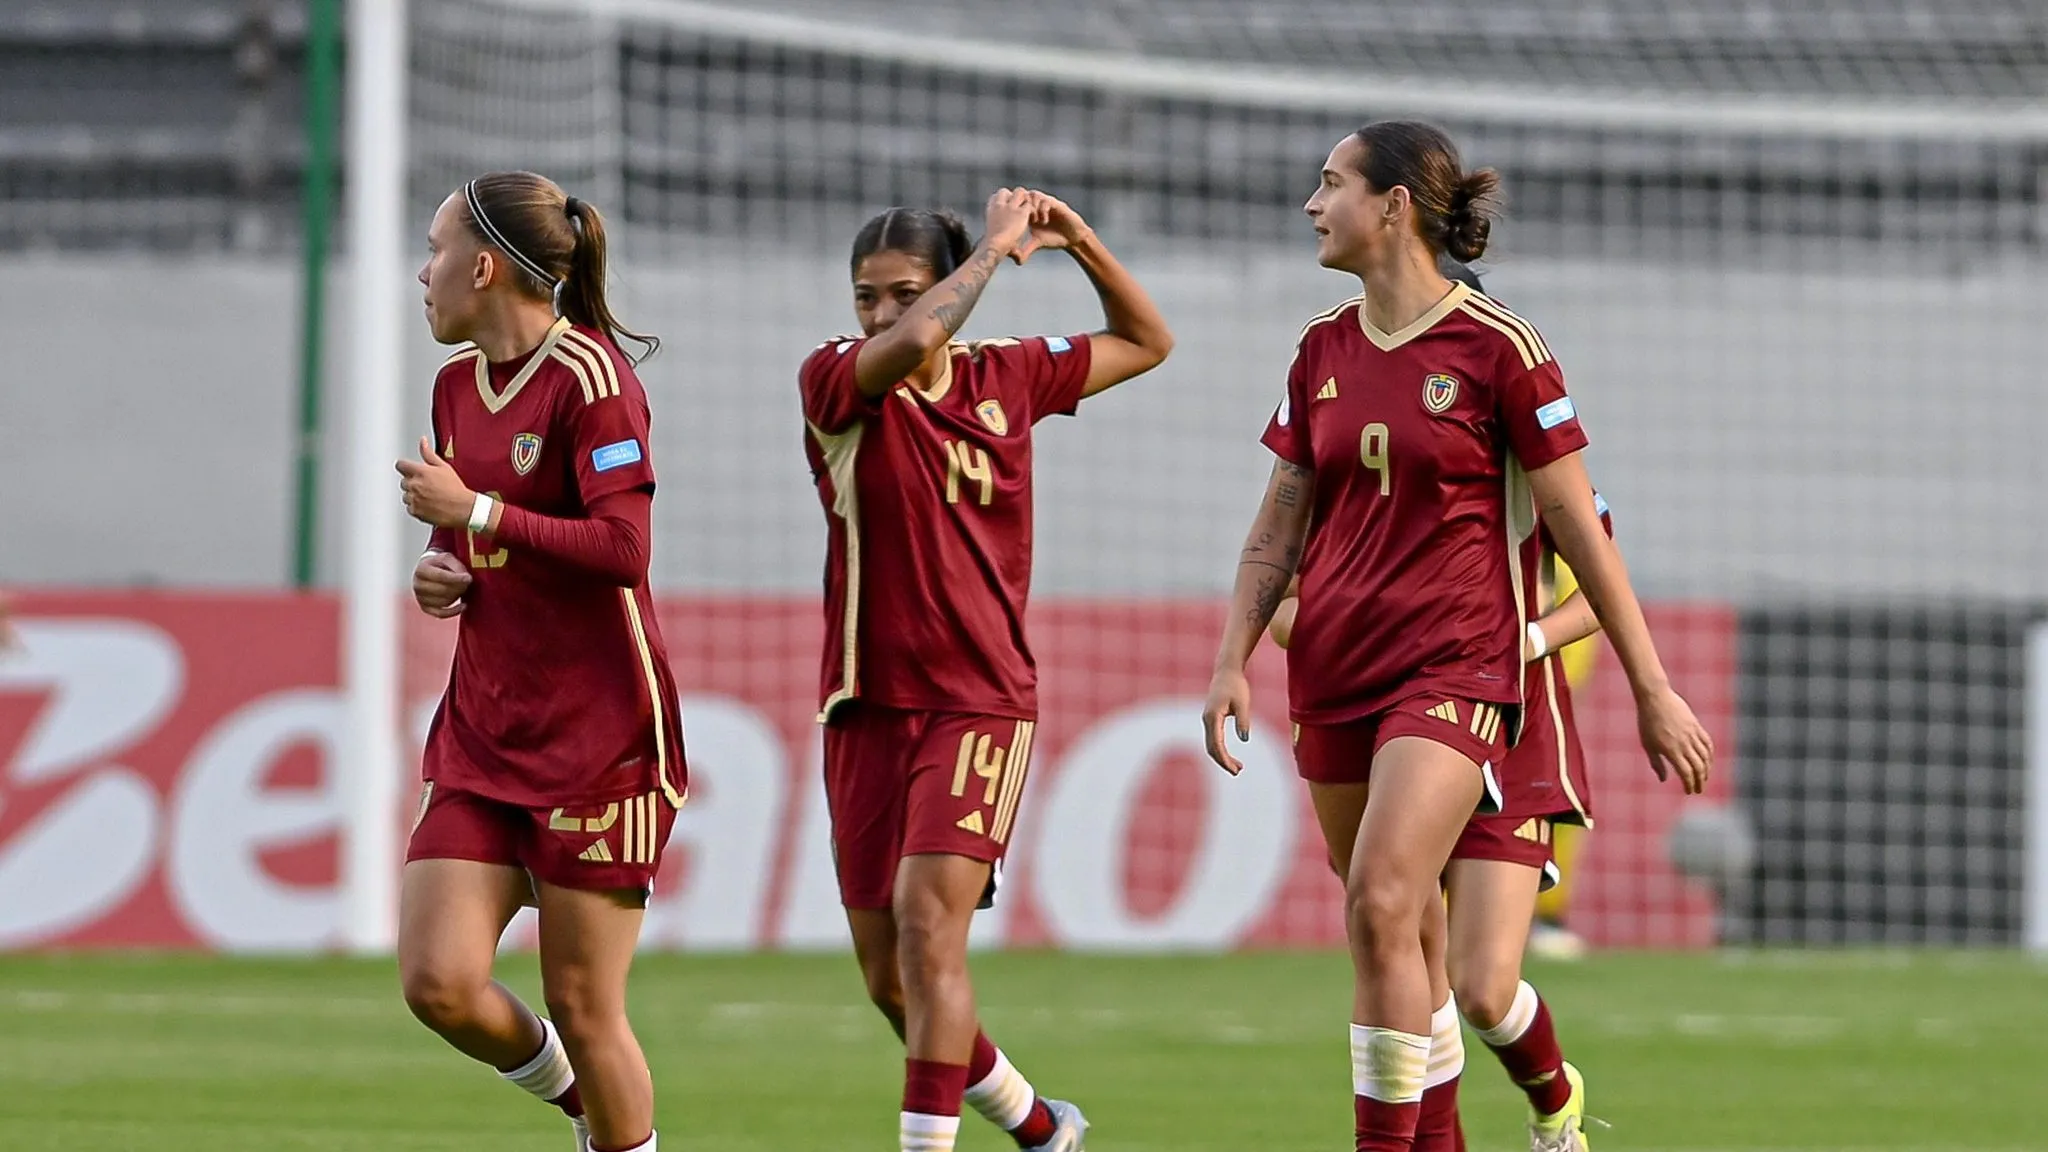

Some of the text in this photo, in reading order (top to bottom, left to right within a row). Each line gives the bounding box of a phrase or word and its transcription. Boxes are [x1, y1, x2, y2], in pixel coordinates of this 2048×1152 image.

[944, 439, 993, 505] 14
[1360, 423, 1390, 496] 9
[951, 731, 1004, 805] 14
